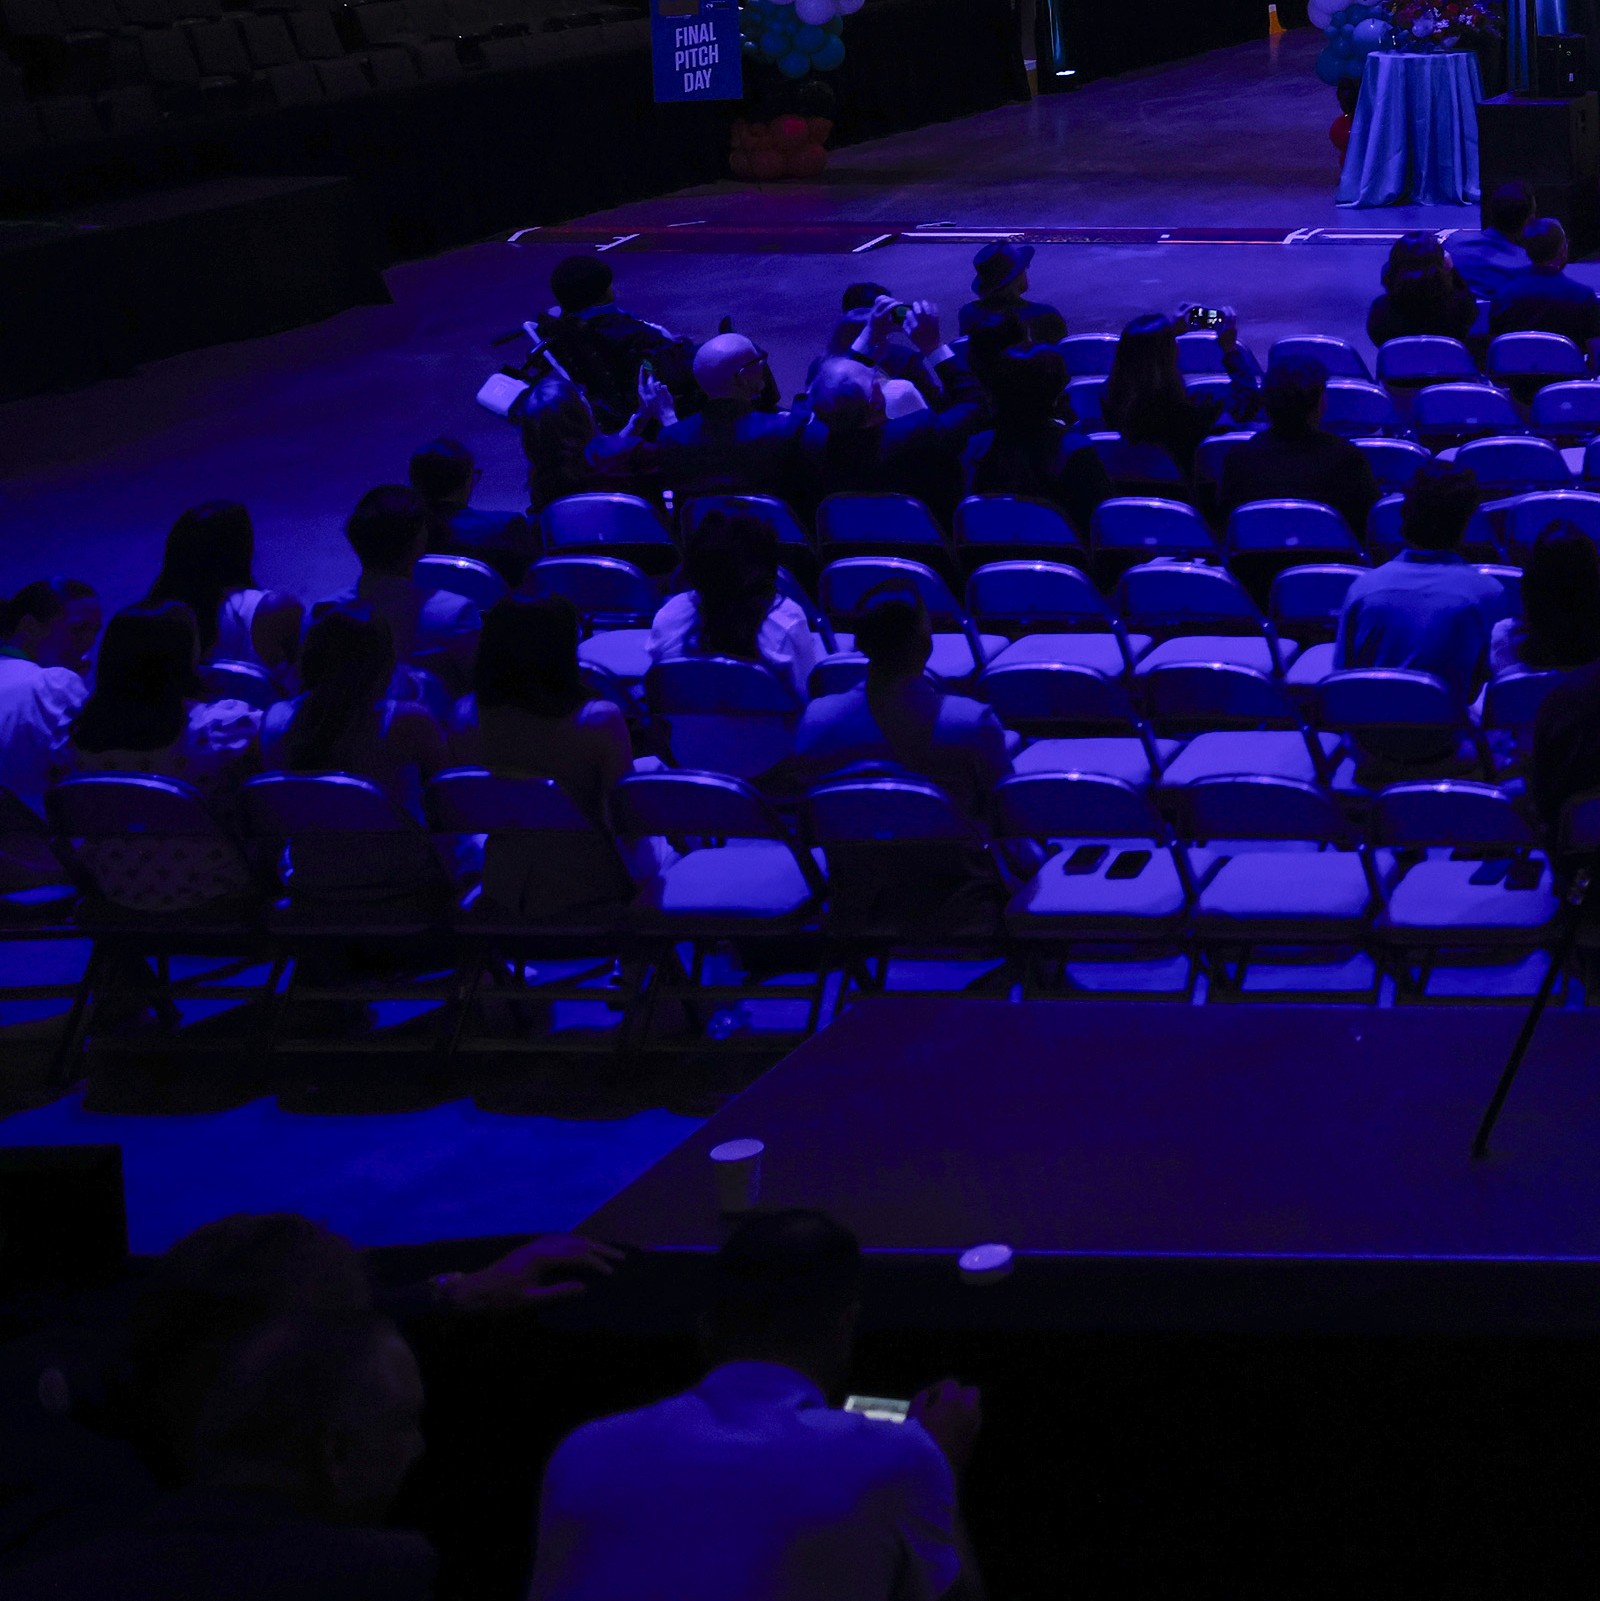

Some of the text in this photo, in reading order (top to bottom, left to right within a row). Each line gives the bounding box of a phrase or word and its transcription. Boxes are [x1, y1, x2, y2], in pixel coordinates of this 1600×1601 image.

[675, 22, 717, 48] FINAL
[675, 43, 719, 71] PITCH
[684, 68, 712, 93] DAY
